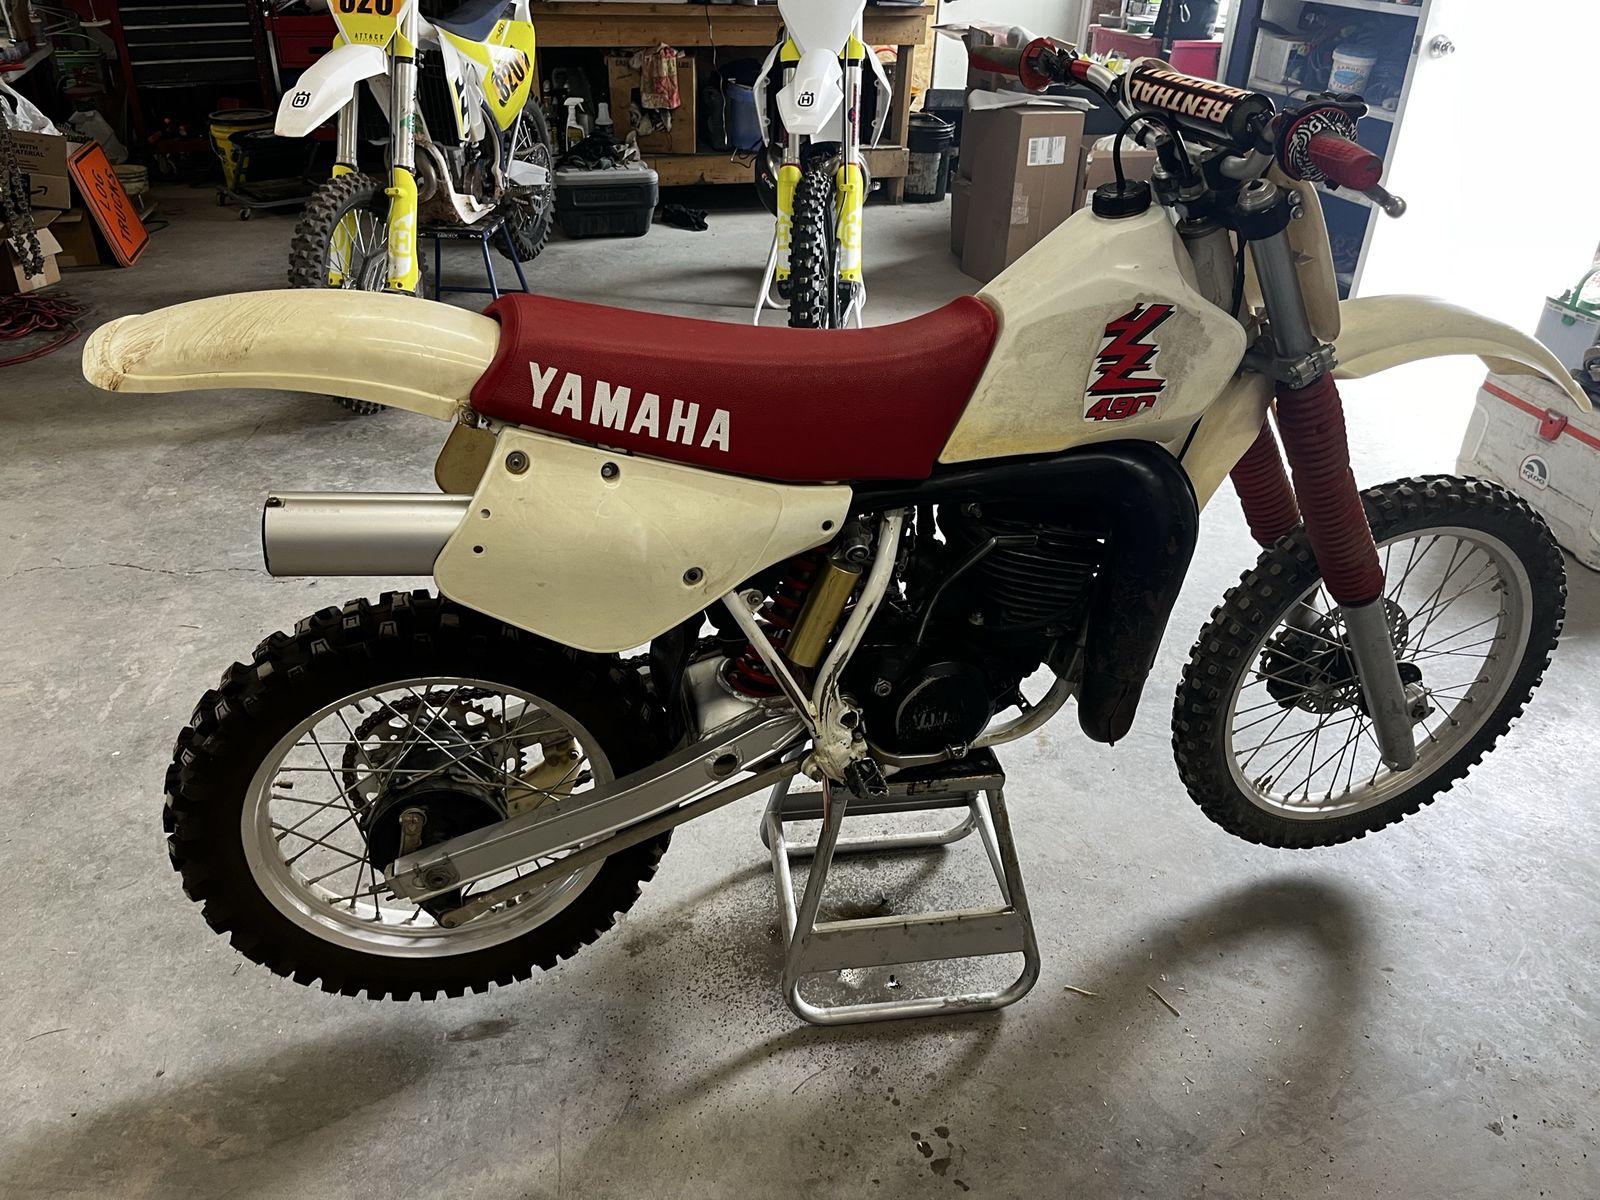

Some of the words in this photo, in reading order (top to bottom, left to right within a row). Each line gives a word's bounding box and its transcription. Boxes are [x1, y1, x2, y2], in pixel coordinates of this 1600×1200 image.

[354, 32, 384, 40] ATTACK
[1131, 79, 1234, 124] RENTHAL
[19, 143, 39, 151] WITH
[92, 168, 111, 211] LOG
[104, 168, 133, 245] TRUCKS
[529, 361, 730, 452] YAMAHA
